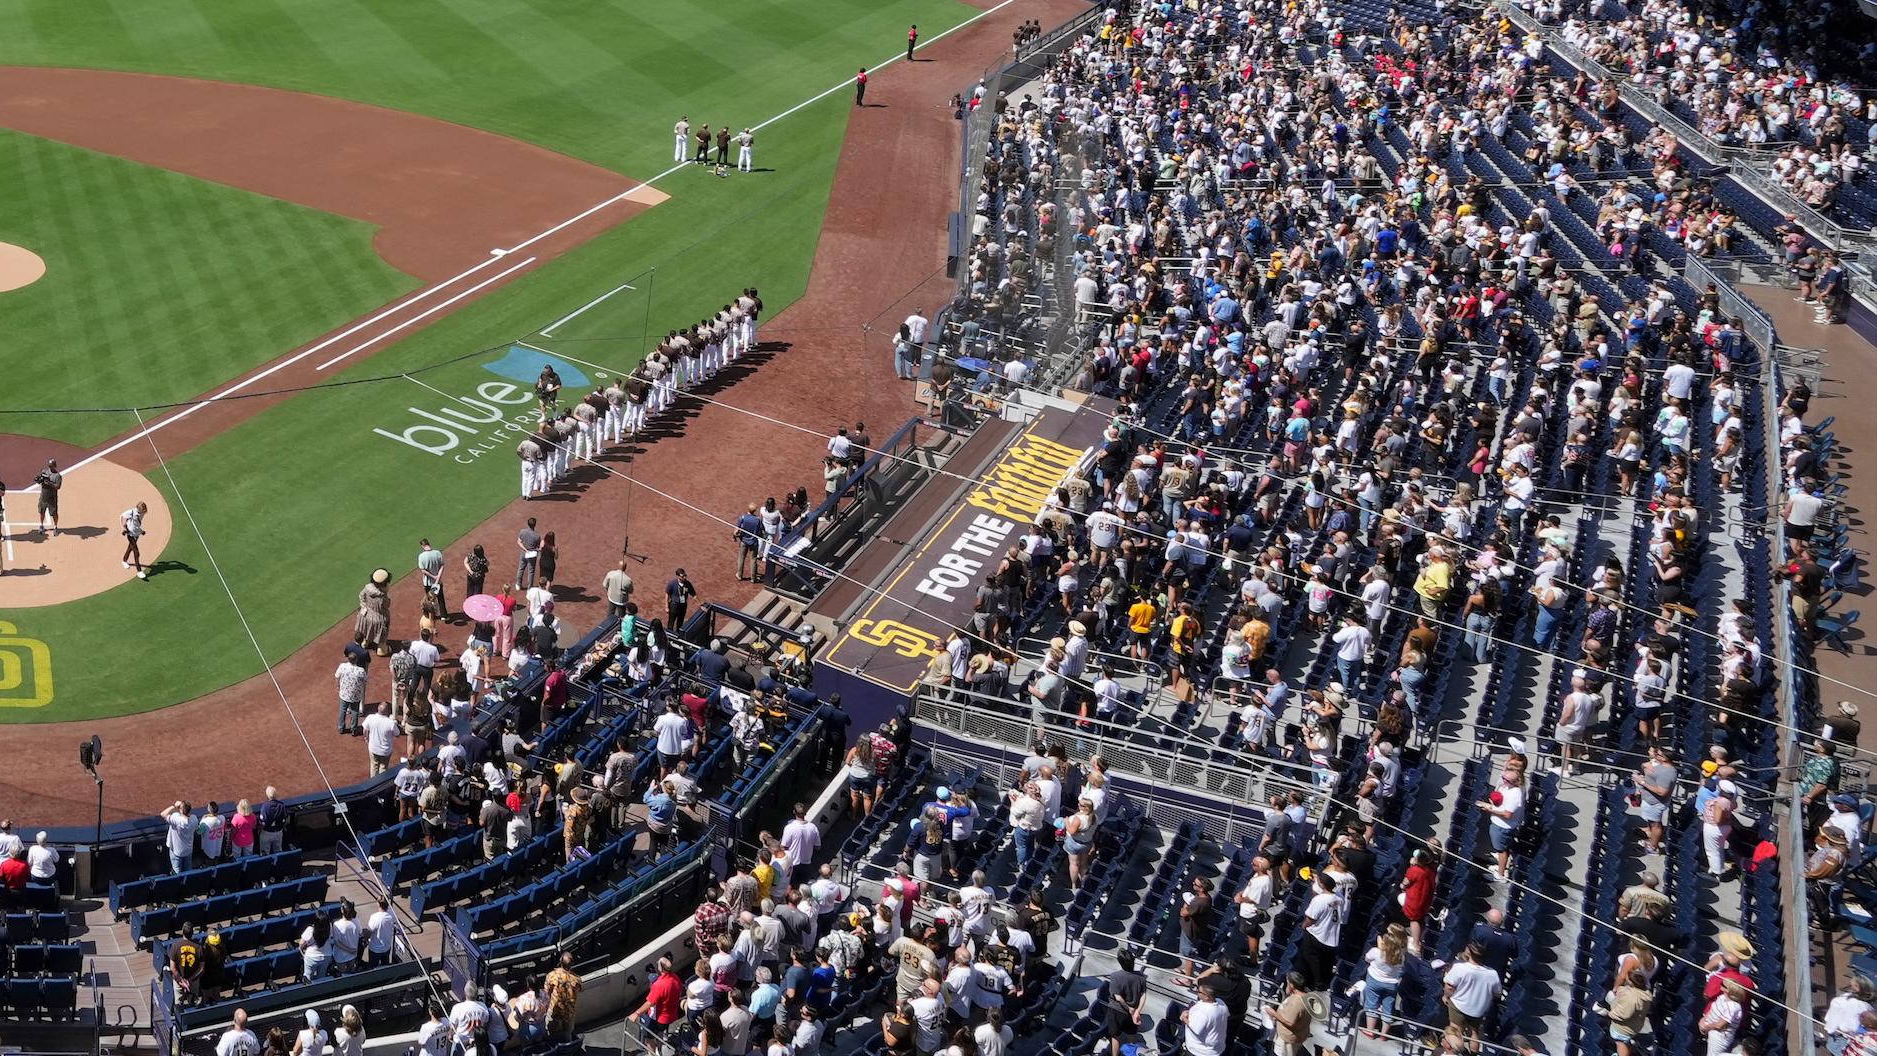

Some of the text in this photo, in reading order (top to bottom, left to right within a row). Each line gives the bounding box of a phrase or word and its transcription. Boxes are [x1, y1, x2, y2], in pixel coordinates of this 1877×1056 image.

[372, 381, 534, 457] blue
[454, 398, 565, 465] CALIFORN
[1071, 486, 1083, 496] 23
[1098, 521, 1111, 533] 23
[957, 513, 1015, 558] THE
[914, 554, 983, 603] FOR
[404, 781, 418, 793] 23
[209, 829, 224, 842] 23
[180, 953, 196, 969] 19
[904, 952, 920, 969] 23
